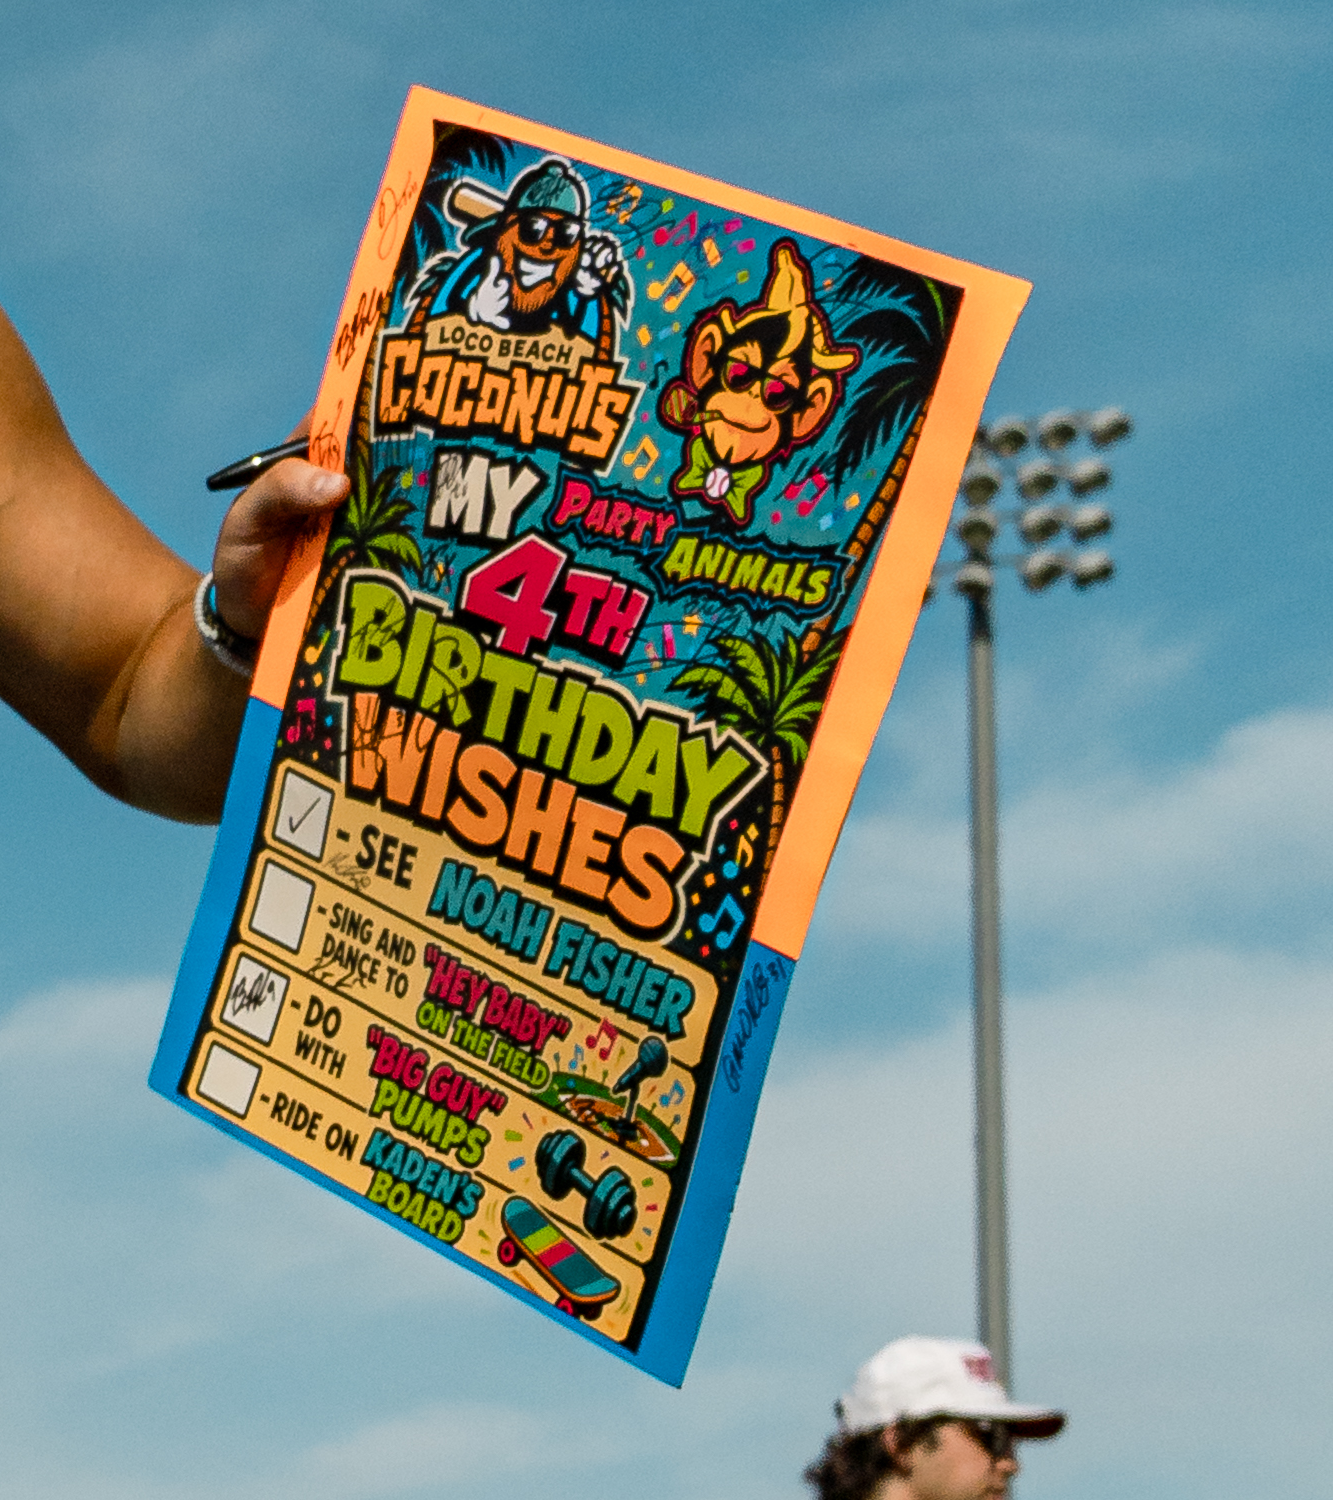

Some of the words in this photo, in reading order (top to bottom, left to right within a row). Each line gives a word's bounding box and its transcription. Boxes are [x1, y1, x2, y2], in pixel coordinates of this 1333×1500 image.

[438, 325, 493, 352] LOCO
[498, 338, 574, 364] BEACH
[377, 337, 633, 460] COCONUTS
[428, 451, 541, 541] MY
[554, 479, 678, 545] PARTY
[461, 533, 650, 657] 4TH
[661, 536, 833, 605] ANIMALS
[338, 580, 752, 838] BIRTHDAY
[350, 691, 686, 931] WISHES
[321, 932, 382, 986] DANCE
[384, 965, 410, 1000] TO
[329, 901, 375, 946] SING
[376, 927, 417, 968] AND
[355, 823, 419, 891] SEE
[430, 859, 552, 961] NOAH
[545, 918, 696, 1038] FISHER
[294, 1029, 347, 1079] WITH
[303, 994, 342, 1040] DO
[417, 1001, 453, 1036] ON
[452, 1017, 493, 1058] THE
[490, 1040, 549, 1088] FIELD
[269, 1091, 323, 1141] RIDE
[324, 1122, 360, 1162] ON
[370, 1079, 489, 1166] PUMPS
[363, 1130, 483, 1217] KADEN'S
[366, 1171, 464, 1243] BOARD
